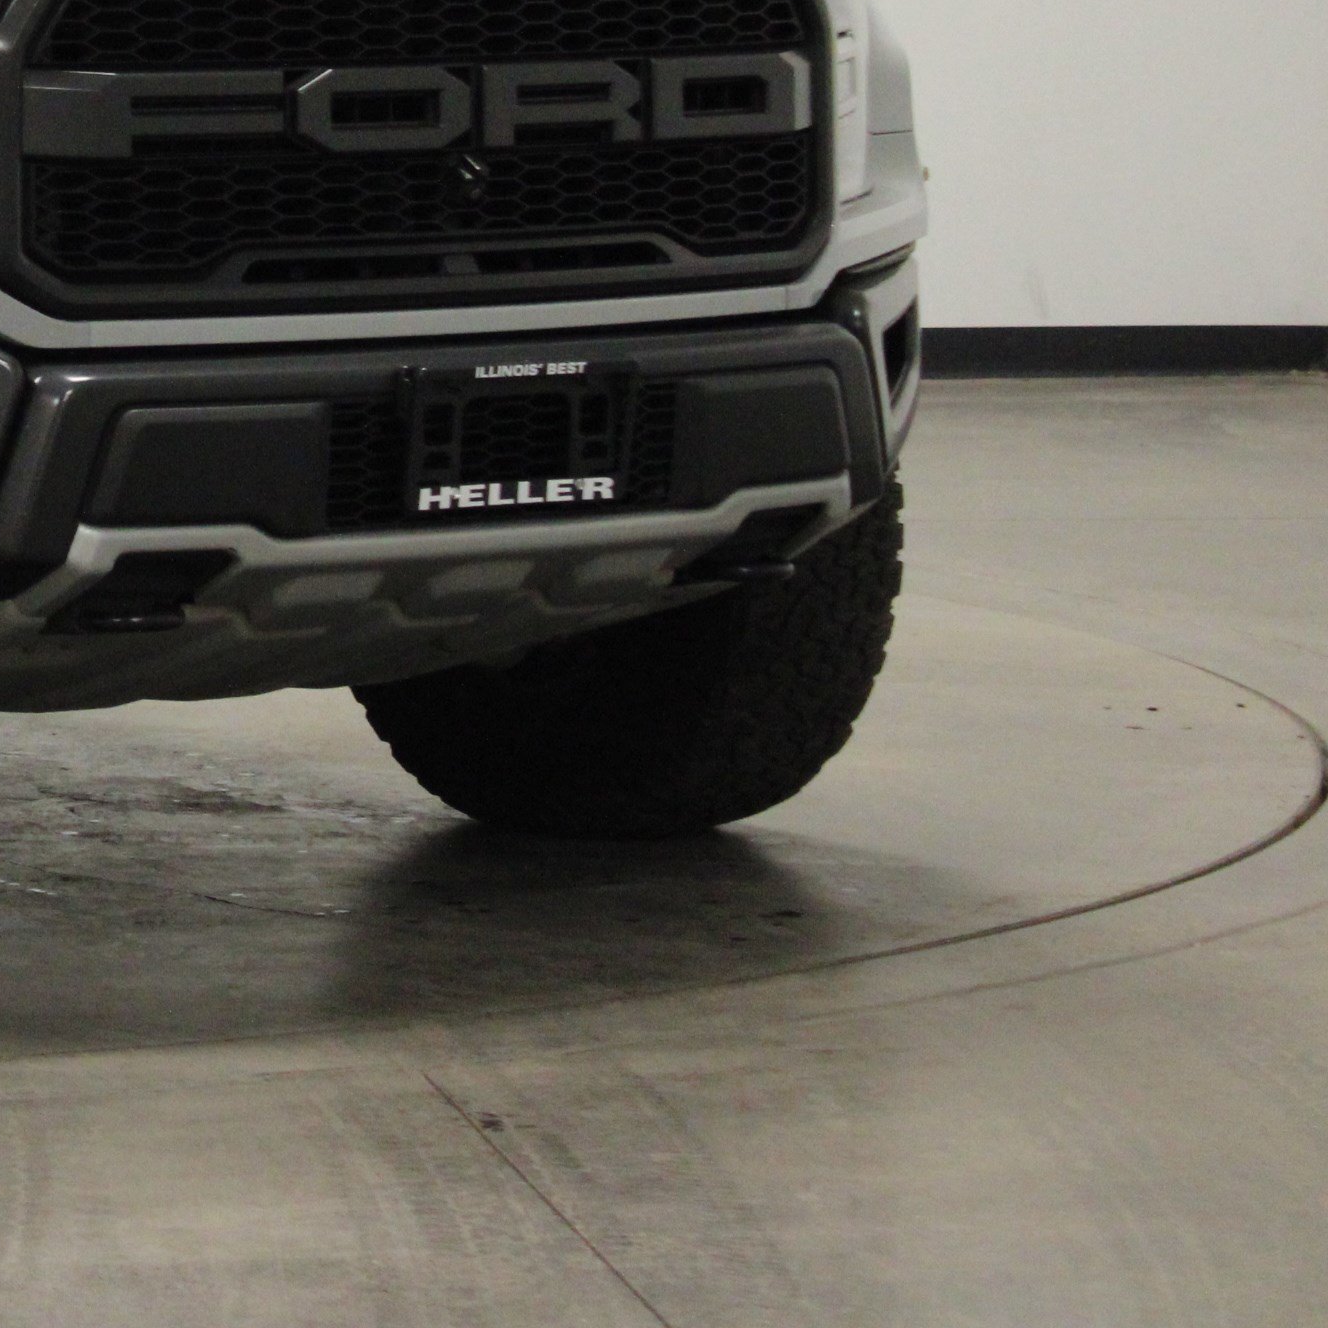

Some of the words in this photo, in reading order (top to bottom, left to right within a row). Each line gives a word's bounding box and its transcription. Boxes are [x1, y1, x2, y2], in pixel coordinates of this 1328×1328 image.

[23, 51, 810, 158] FORD
[546, 361, 587, 375] BEST
[418, 476, 614, 511] HELLER
